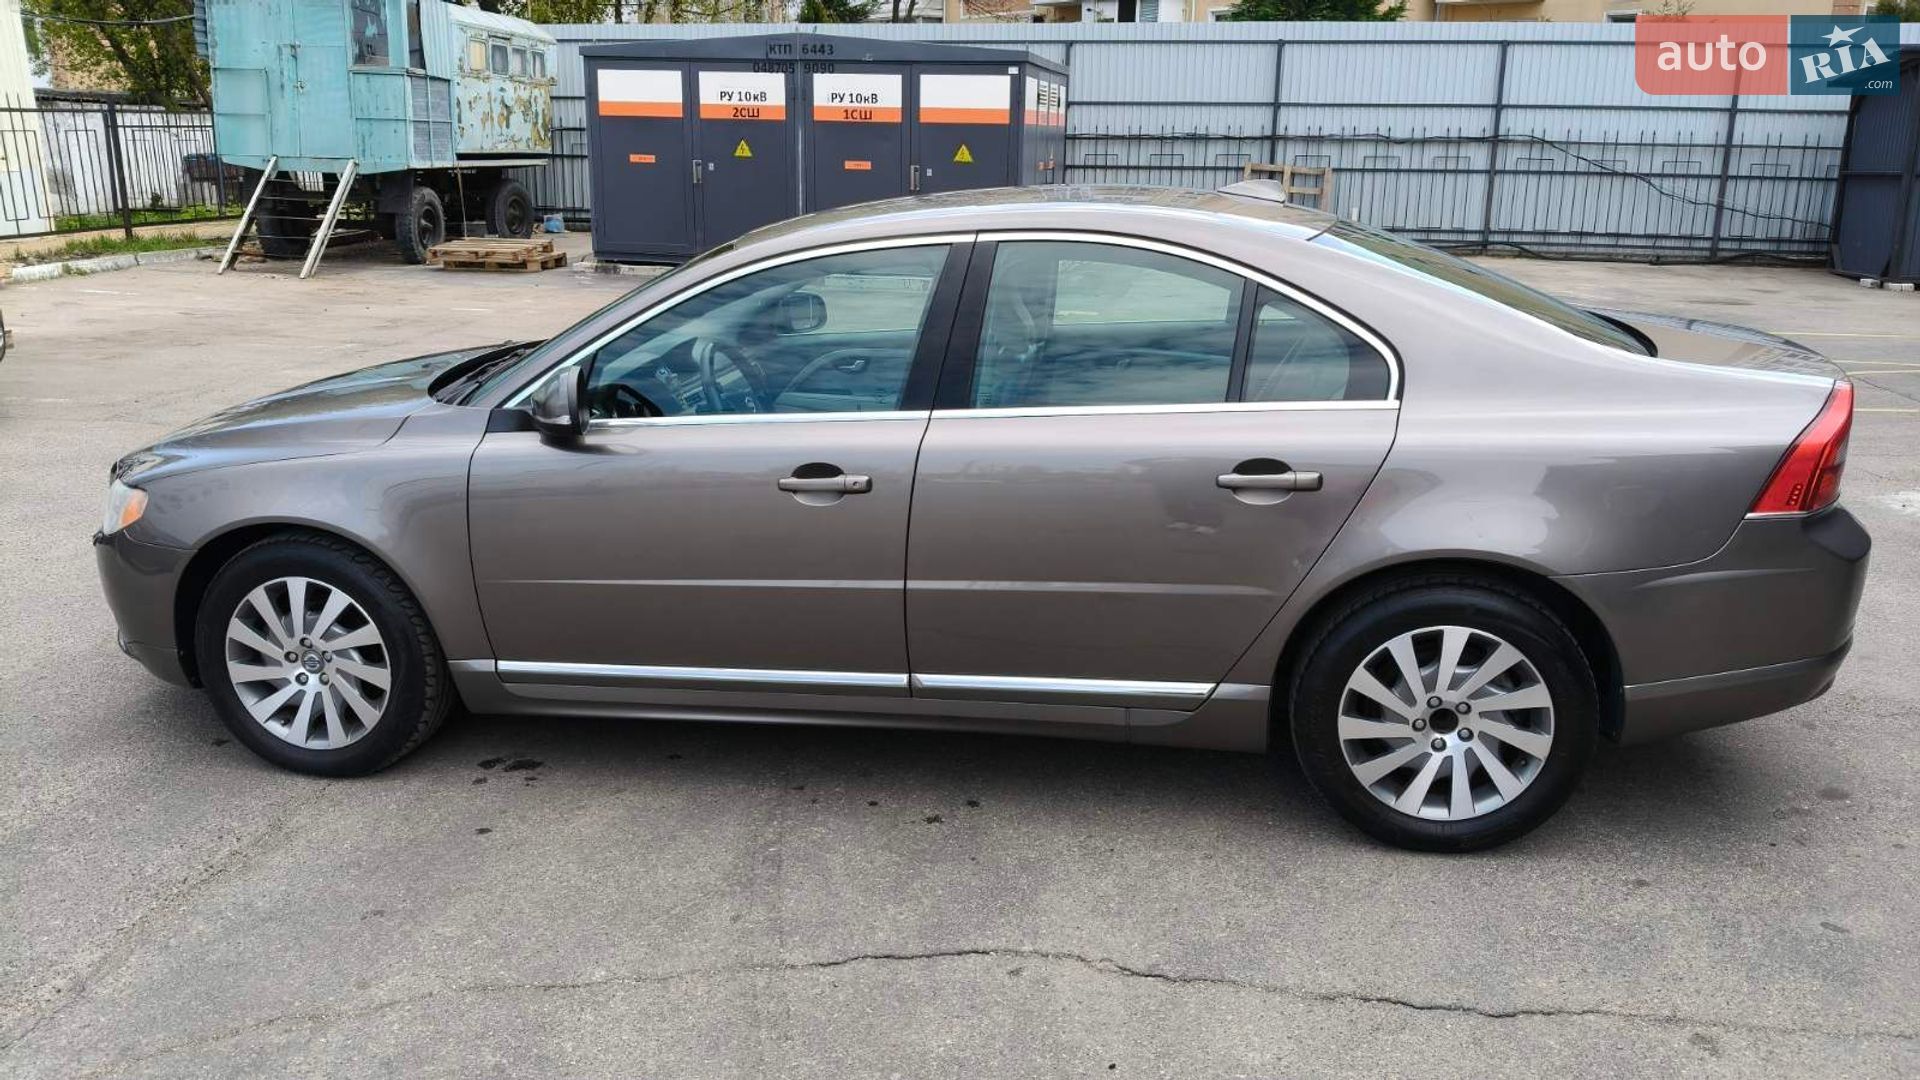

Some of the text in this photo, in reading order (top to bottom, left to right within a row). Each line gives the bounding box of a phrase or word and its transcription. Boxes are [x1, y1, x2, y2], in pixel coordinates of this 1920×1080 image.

[768, 43, 834, 55] КТП 6443
[803, 62, 834, 74] 9090
[720, 91, 767, 102] РУ 10кВ
[831, 93, 879, 104] РУ 10кВ
[733, 107, 760, 118] 2СШ
[843, 109, 872, 120] 1СШ
